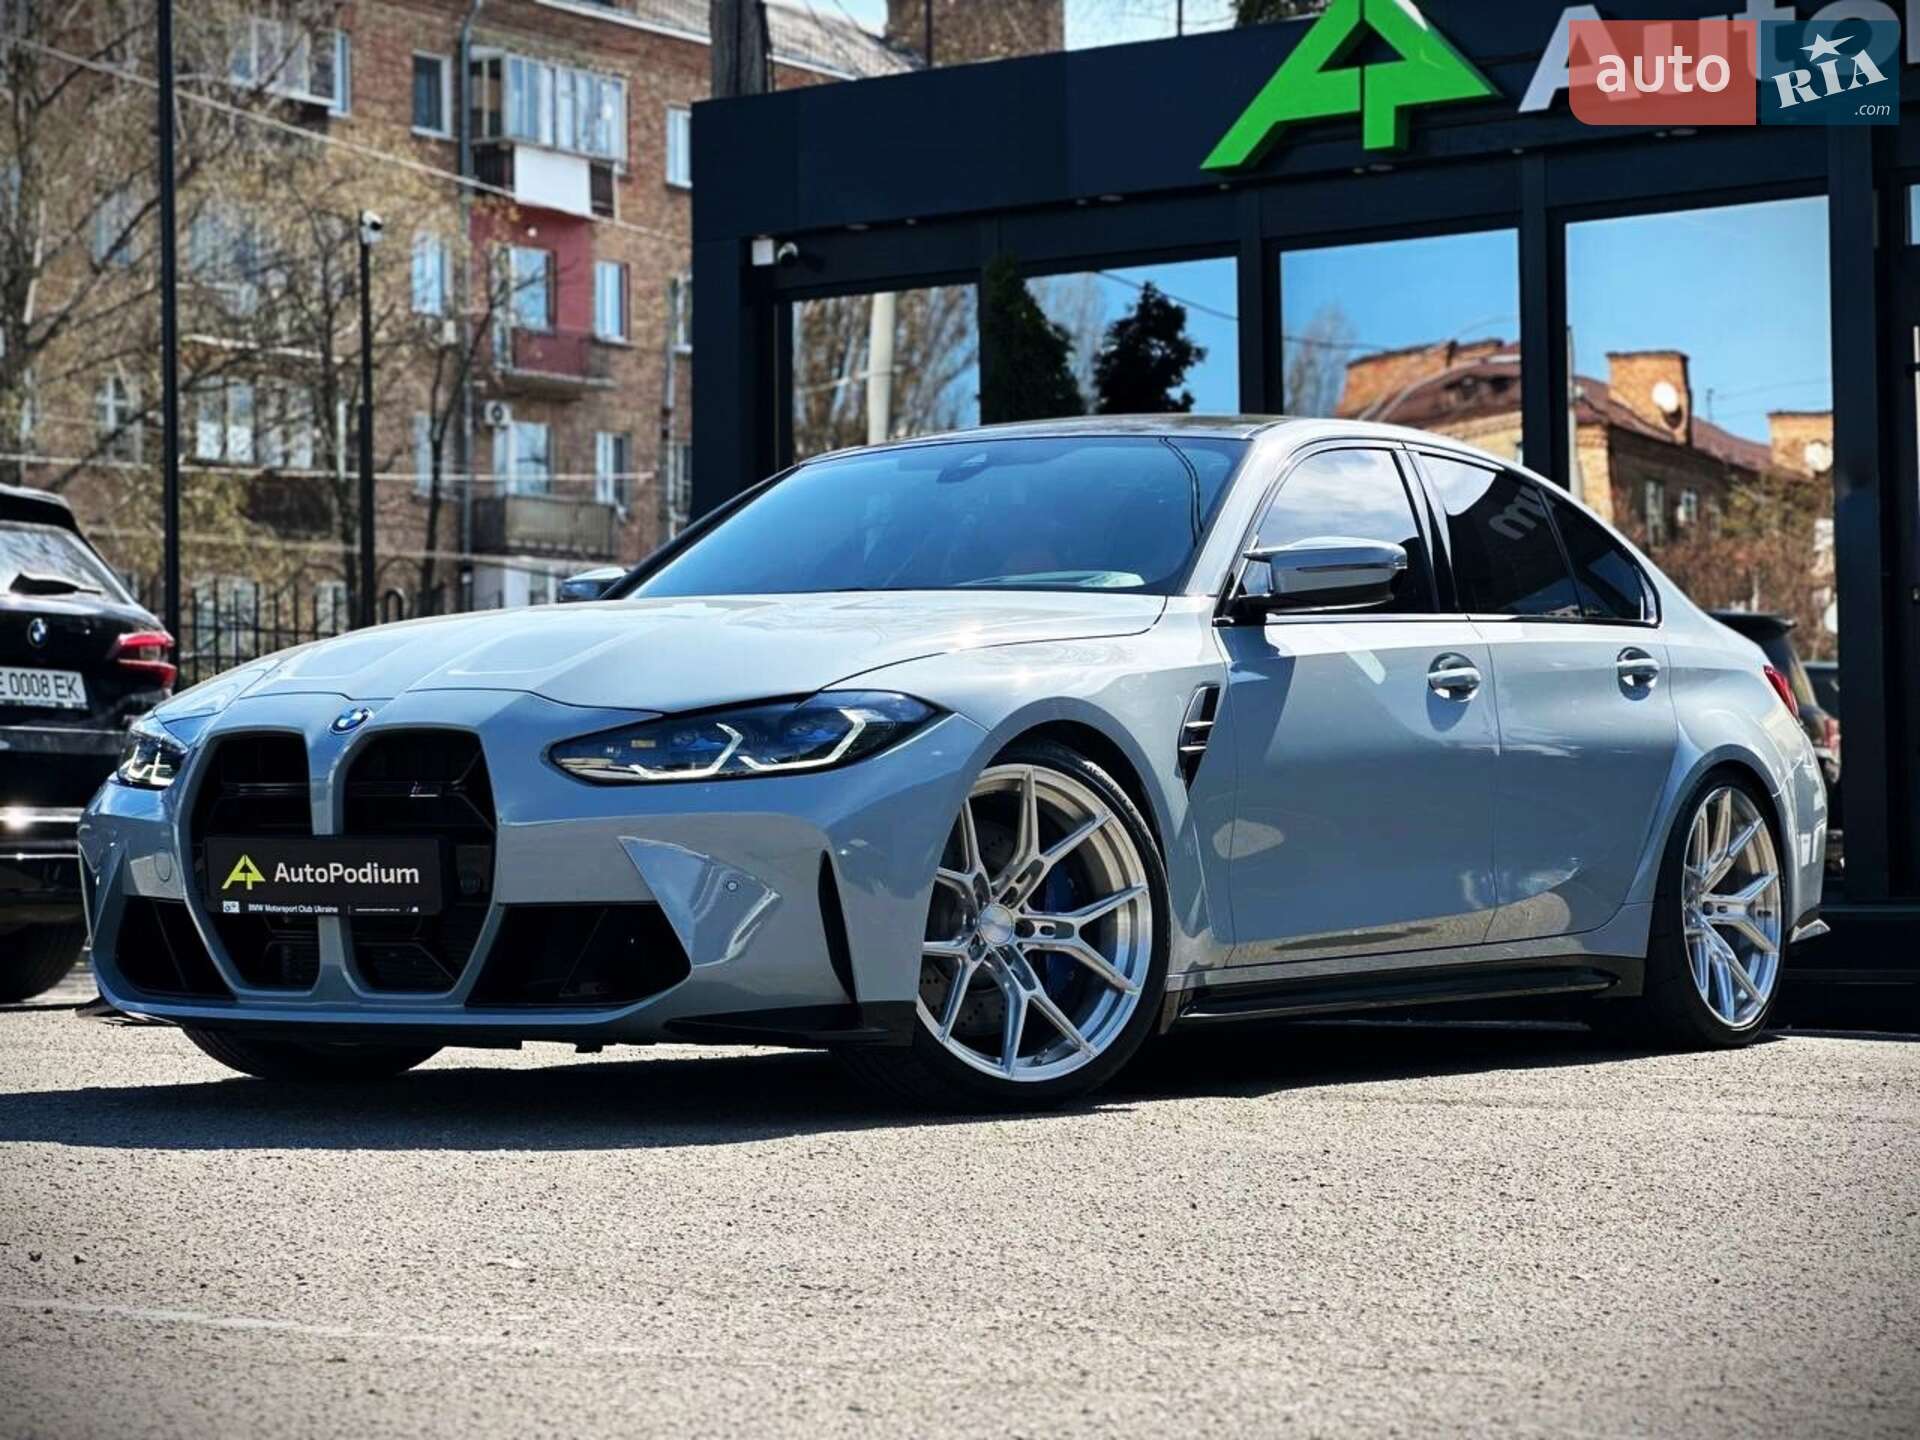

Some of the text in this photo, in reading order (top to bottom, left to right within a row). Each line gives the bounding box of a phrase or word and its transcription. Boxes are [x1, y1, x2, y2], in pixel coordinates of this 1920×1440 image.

[1518, 0, 1920, 113] Auto
[9, 673, 51, 697] 0008
[53, 674, 81, 699] EK
[274, 862, 420, 884] AutoPodium
[248, 903, 339, 913] BMW Motorsport Club Ukraine
